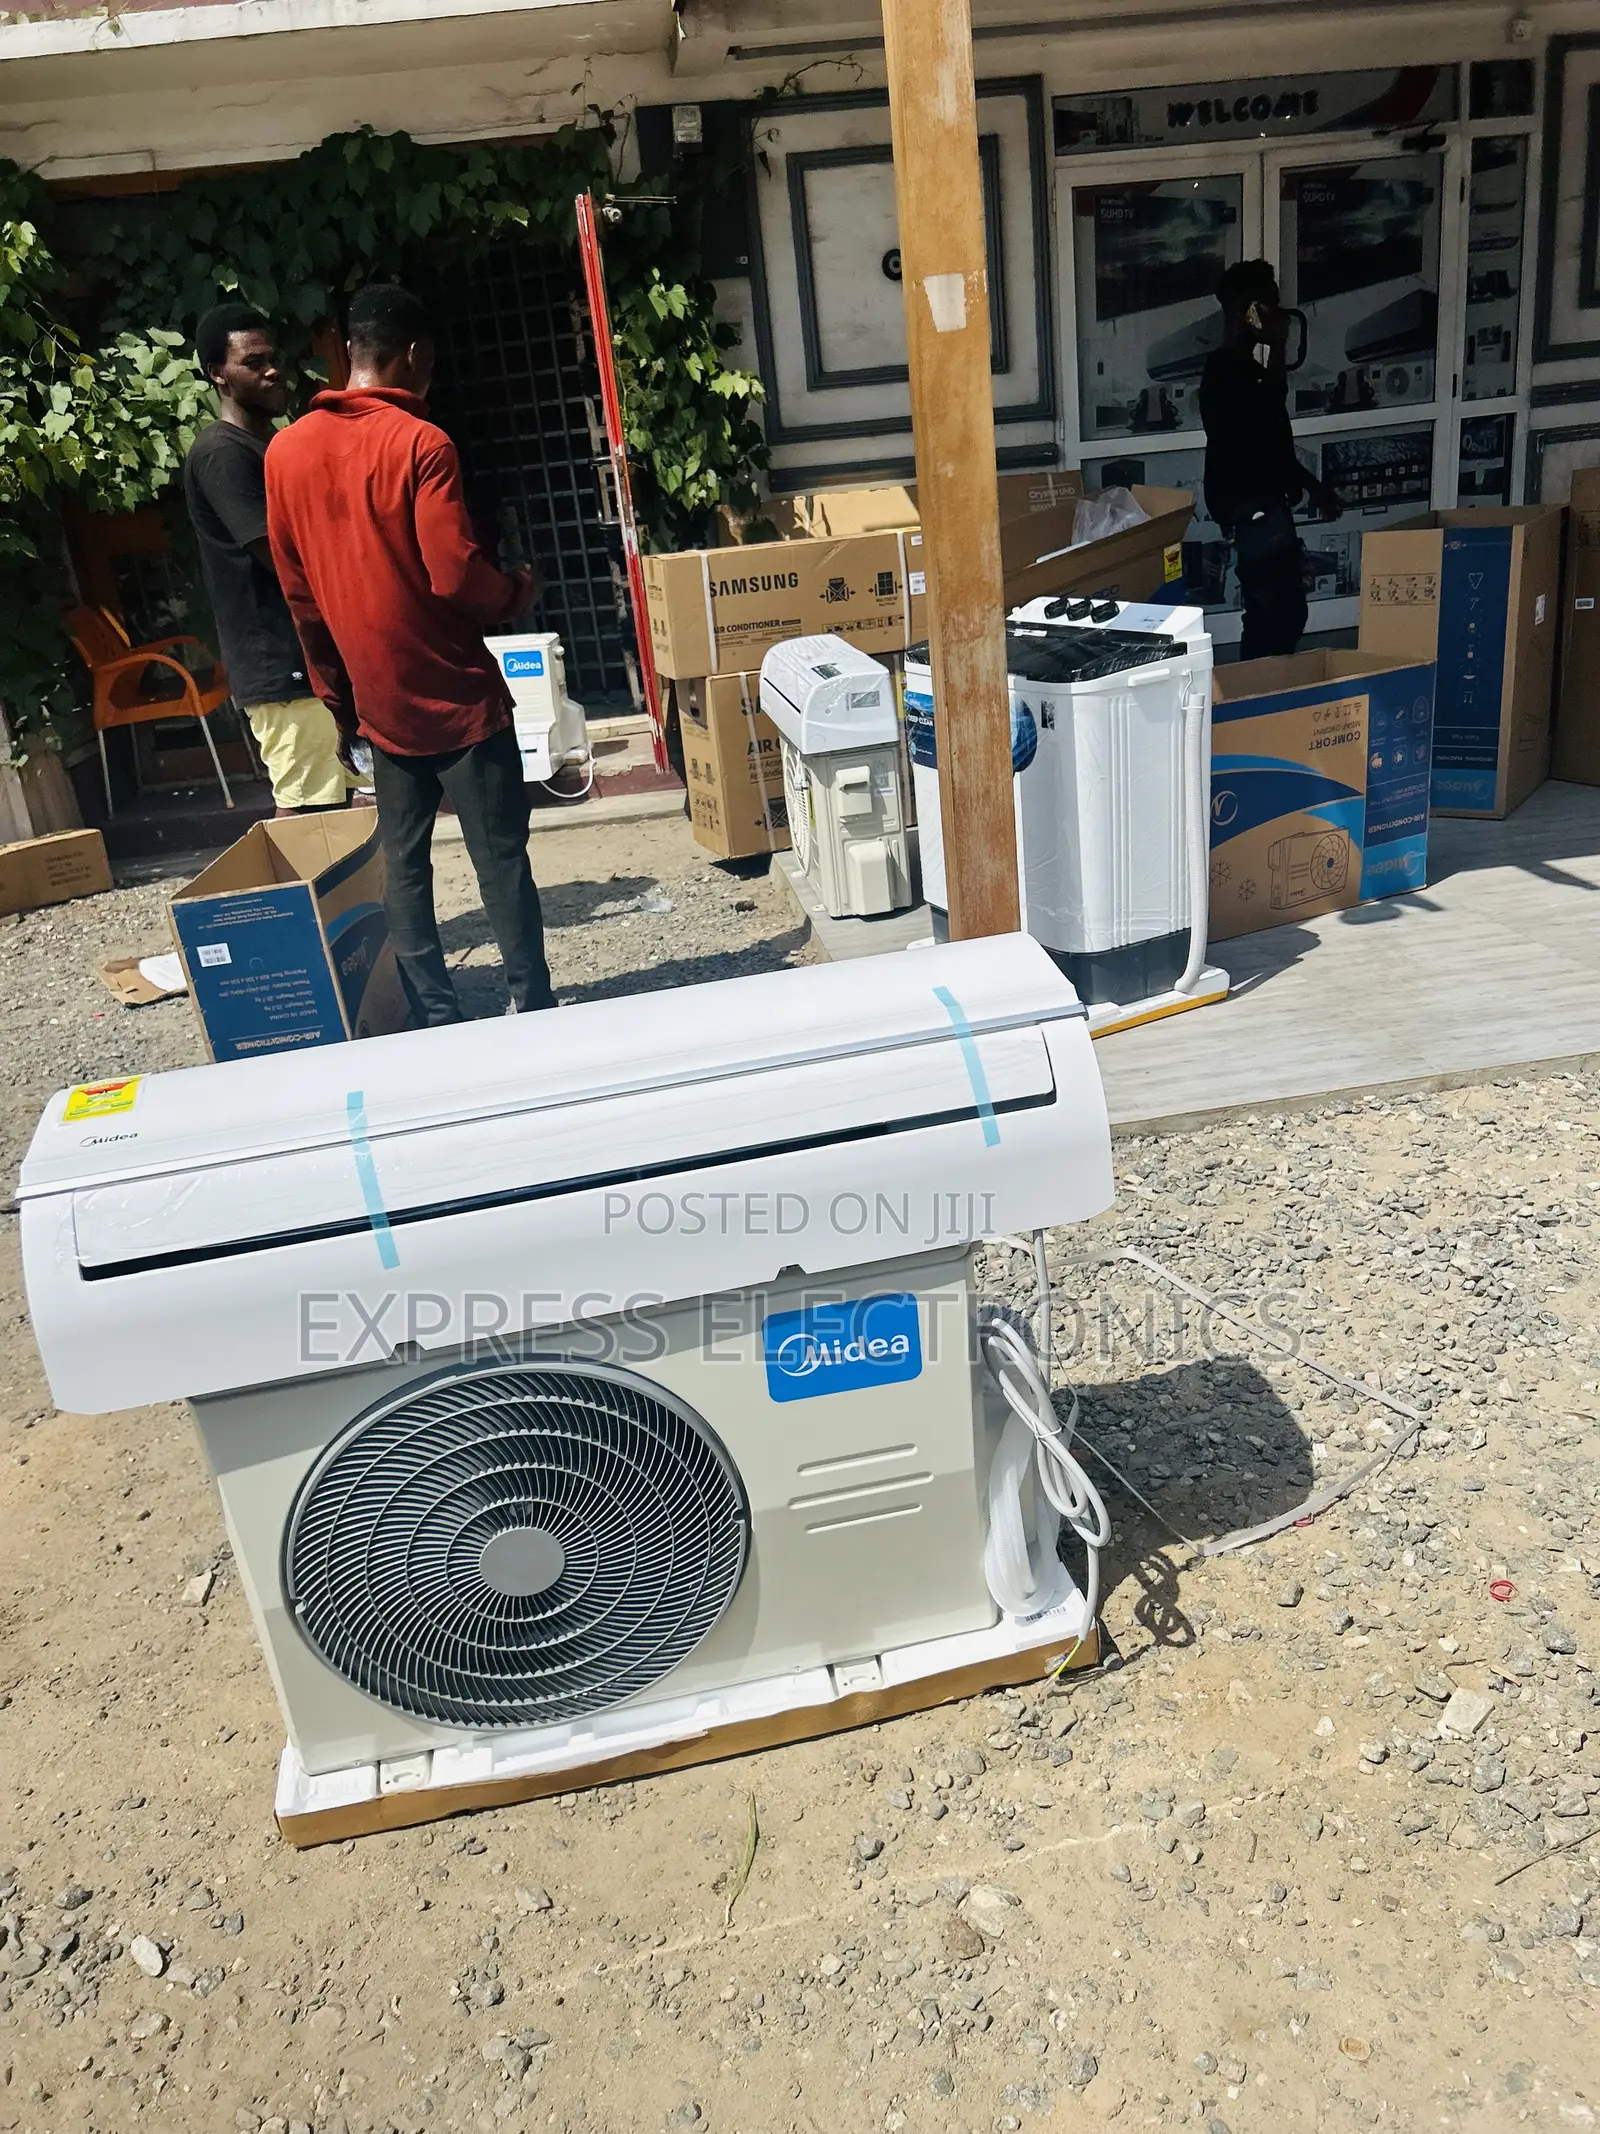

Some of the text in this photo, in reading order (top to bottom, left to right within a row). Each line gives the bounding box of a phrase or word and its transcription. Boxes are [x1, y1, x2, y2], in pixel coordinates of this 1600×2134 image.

[1166, 89, 1320, 129] WELCOME
[709, 572, 799, 599] SAMSUNG
[726, 620, 780, 633] CONDITIONER
[506, 658, 542, 672] Midea
[1308, 730, 1361, 750] COMFORT
[1368, 813, 1424, 834] AIR-CONDITIONER
[1366, 851, 1421, 876] Midea
[268, 1012, 290, 1020] CHINA
[235, 1030, 321, 1050] AIR-CONDITIONER
[80, 1131, 139, 1148] Midea
[778, 1332, 911, 1378] Midea
